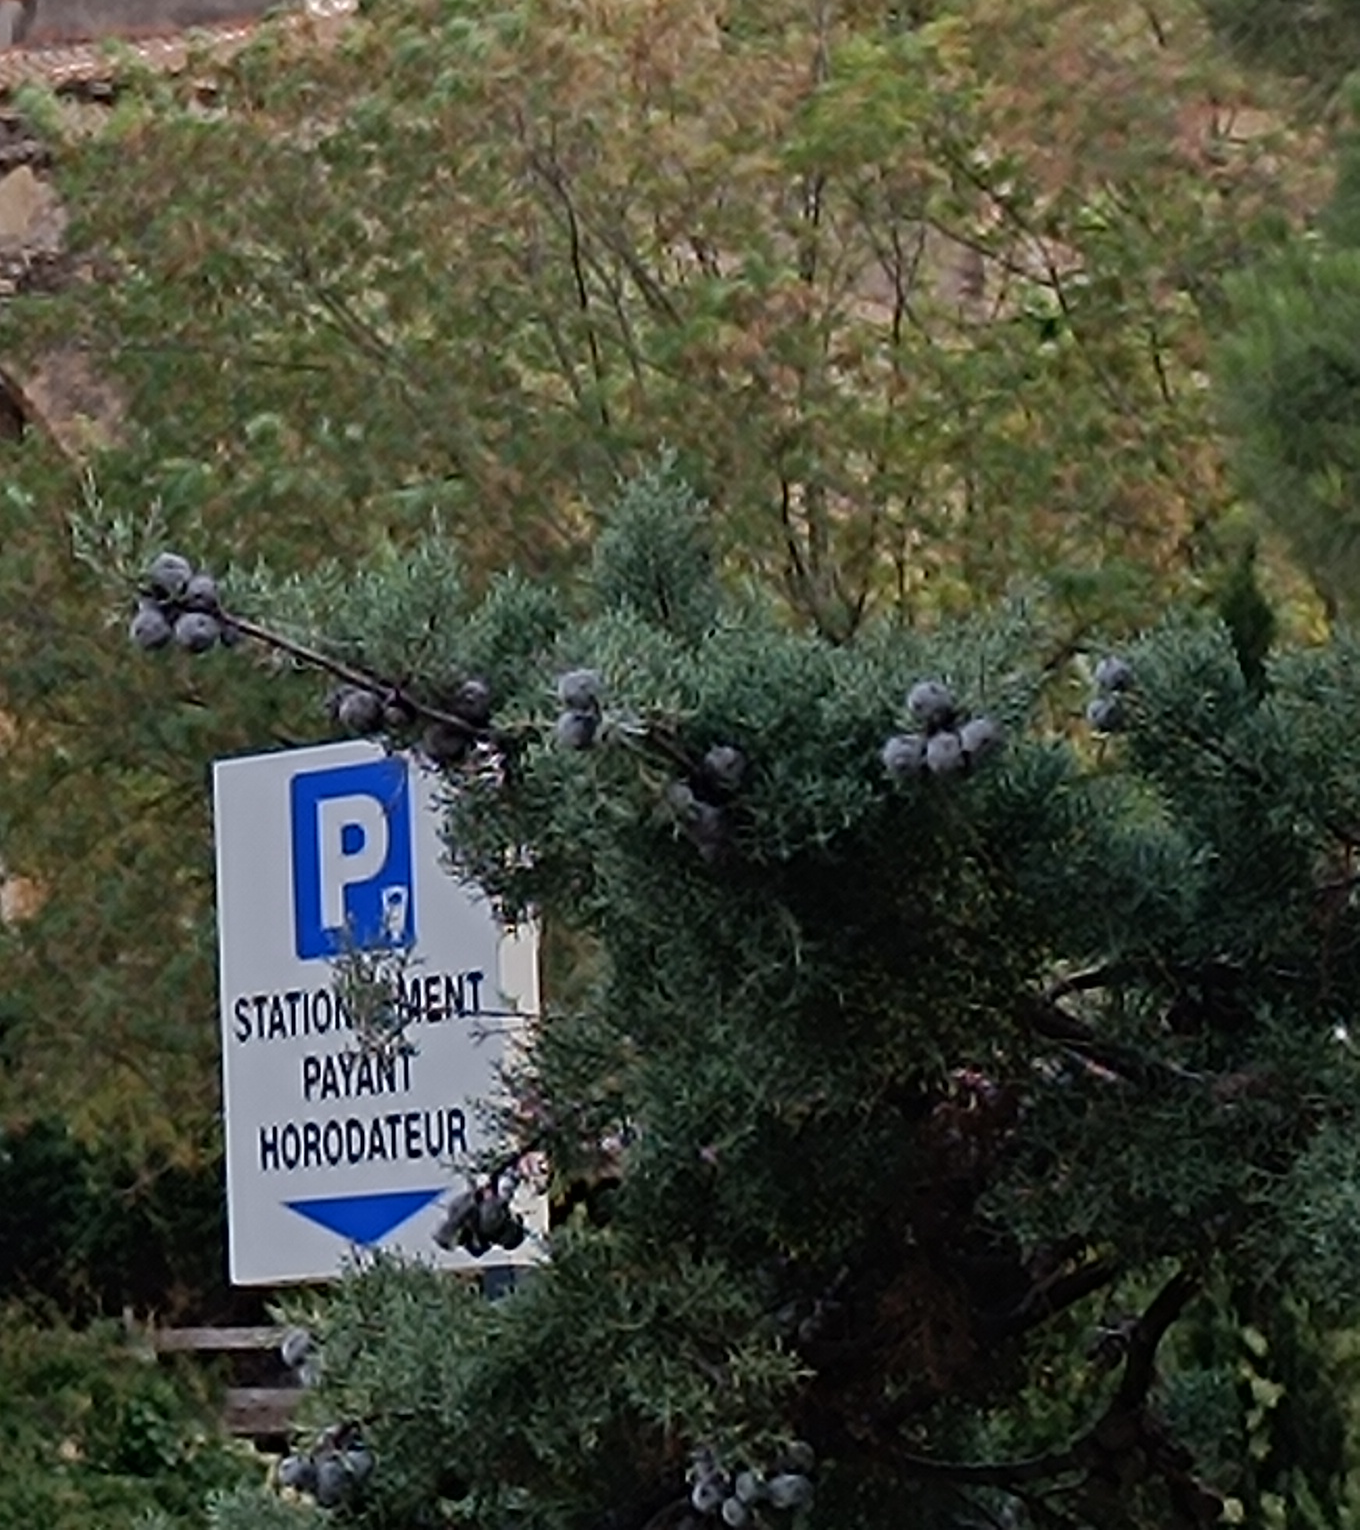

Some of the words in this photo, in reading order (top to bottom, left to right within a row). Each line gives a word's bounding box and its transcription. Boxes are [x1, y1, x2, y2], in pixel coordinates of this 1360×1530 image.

[317, 793, 389, 929] P
[234, 971, 483, 1043] STATIONMENT
[303, 1047, 412, 1101] PAYANT
[259, 1107, 467, 1171] HORODATEUR
